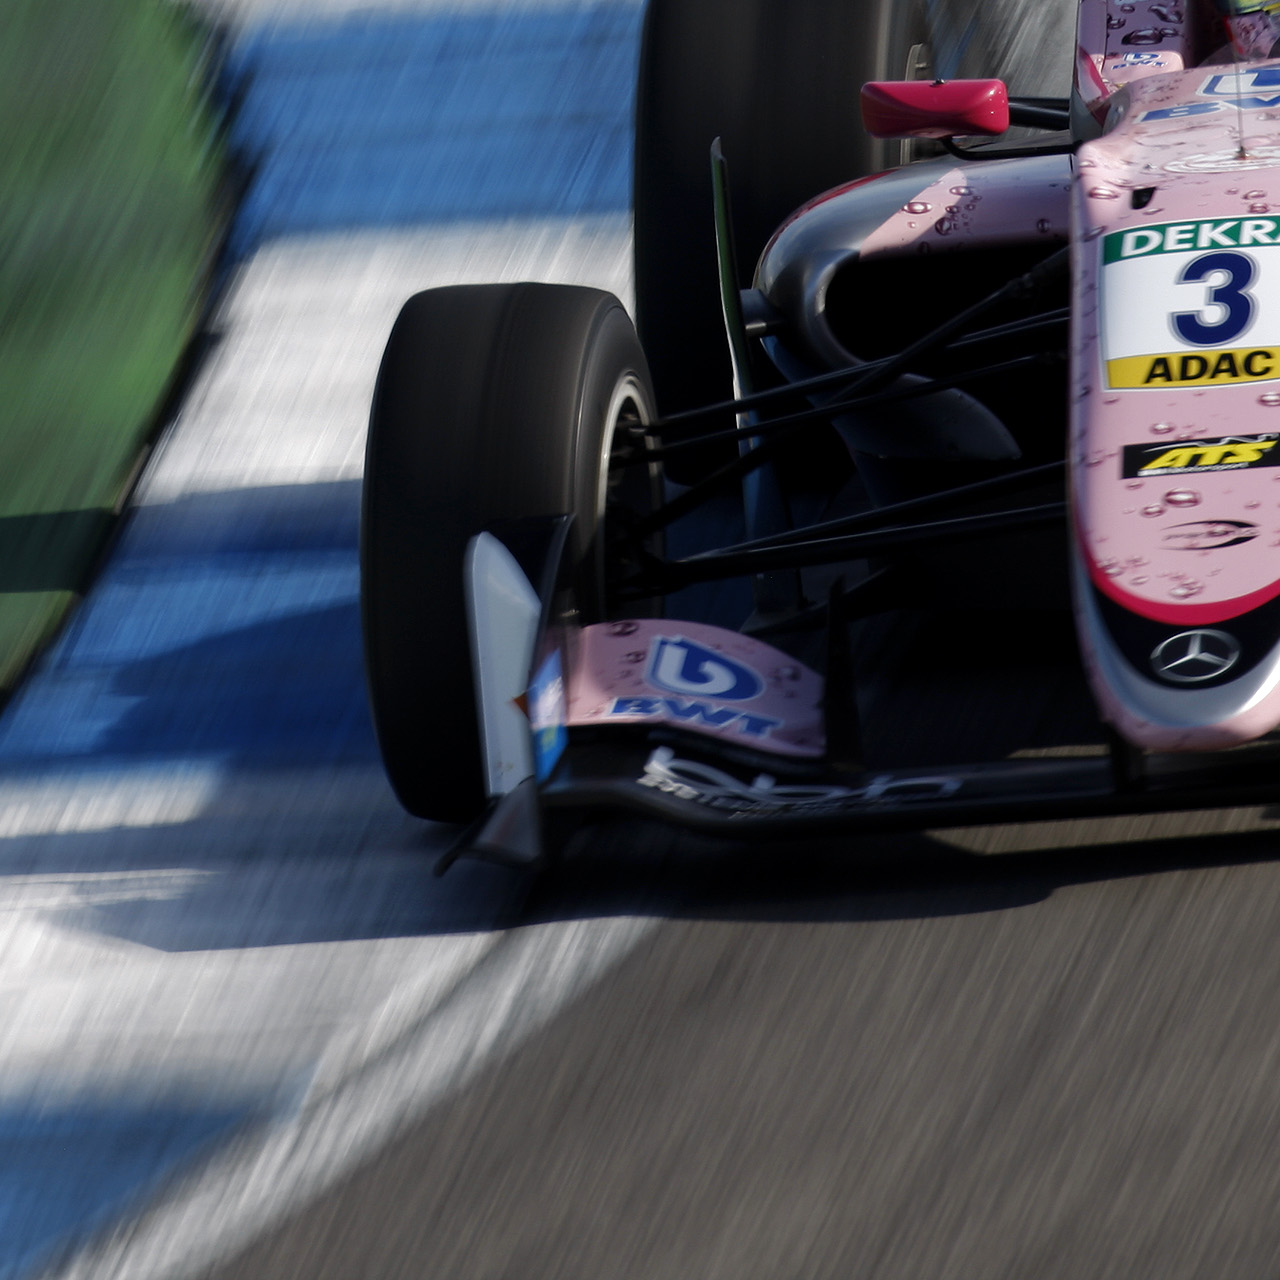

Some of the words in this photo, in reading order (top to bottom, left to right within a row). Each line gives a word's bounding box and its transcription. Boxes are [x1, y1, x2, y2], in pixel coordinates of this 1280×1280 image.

[1168, 249, 1261, 348] 3
[1144, 350, 1273, 384] ADAC
[1139, 440, 1278, 470] ATS
[609, 696, 784, 739] BWT
